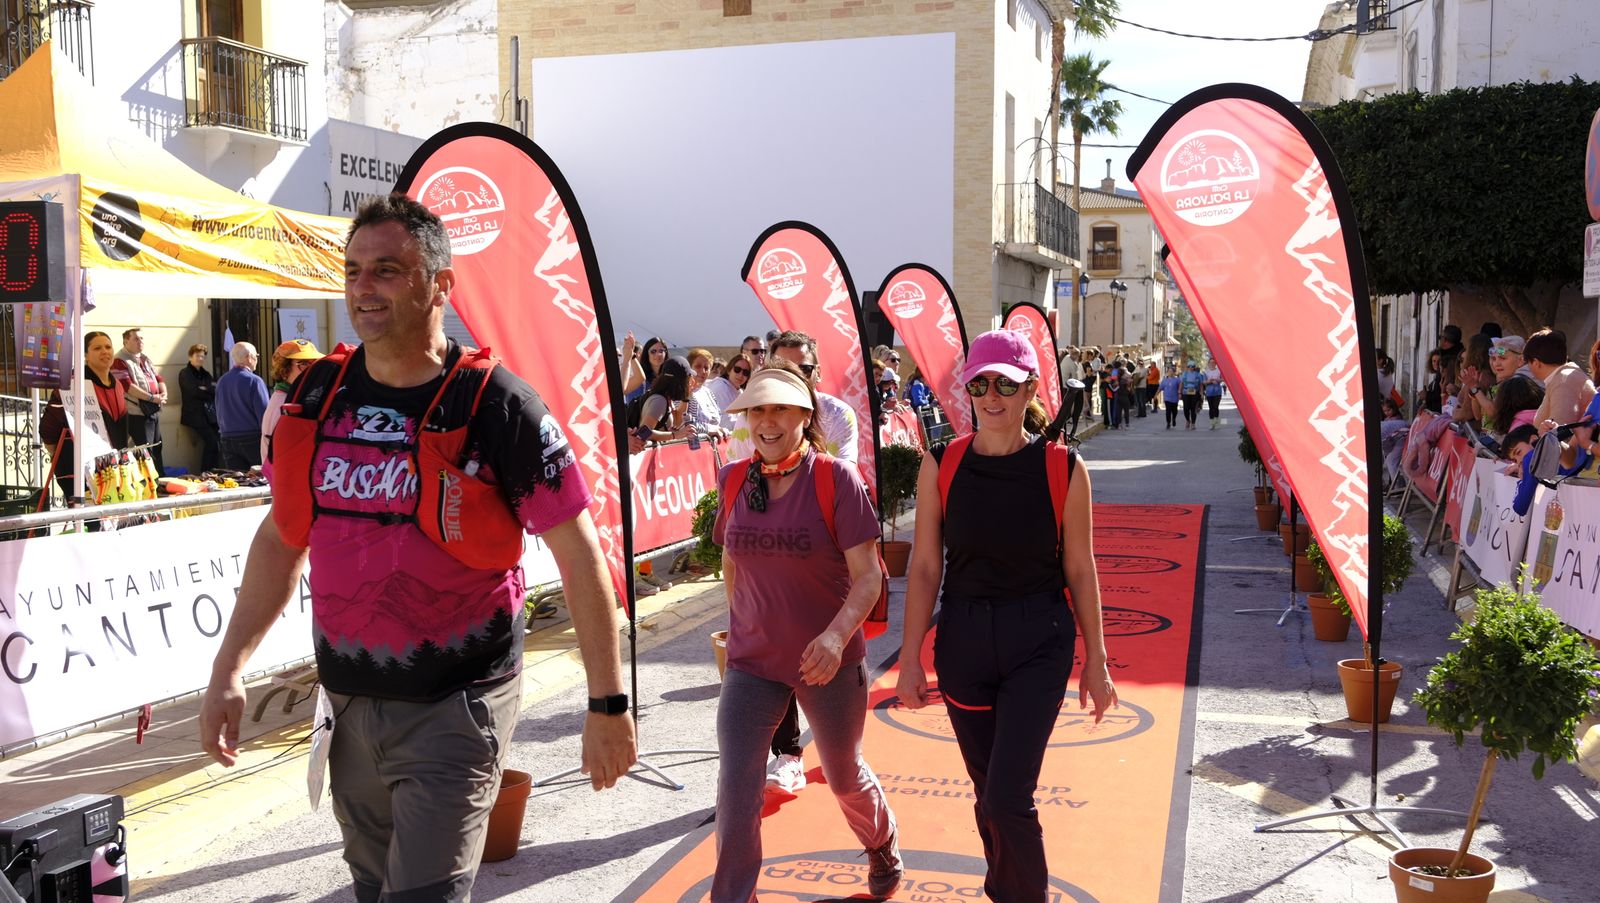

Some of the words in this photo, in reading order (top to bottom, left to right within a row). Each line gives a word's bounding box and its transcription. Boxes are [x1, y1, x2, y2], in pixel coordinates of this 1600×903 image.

[341, 153, 406, 184] EXCELEN
[102, 212, 117, 221] uno
[100, 236, 117, 248] .org
[726, 530, 812, 553] STRONG
[0, 554, 241, 620] AYUNTAMIENT
[1, 571, 312, 685] CANTOA
[876, 773, 971, 787] ntoria
[796, 861, 870, 873] ntoria
[764, 866, 984, 898] POLORA
